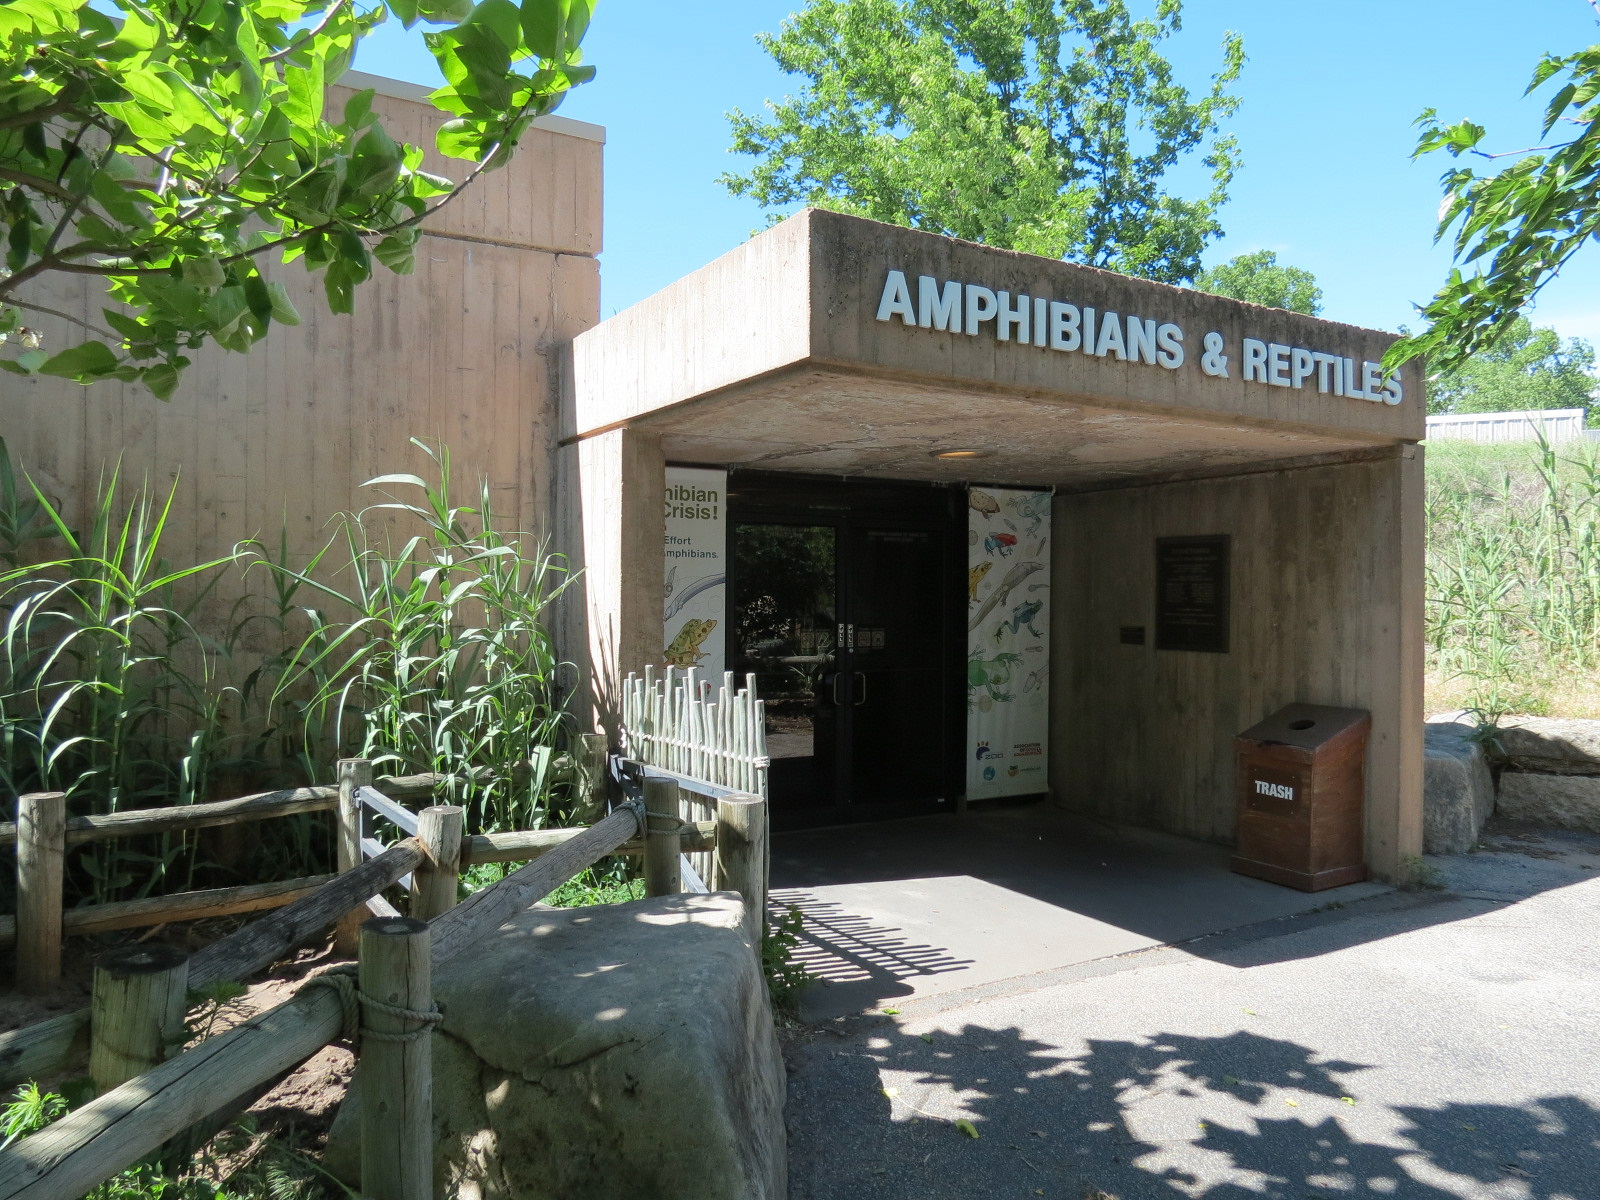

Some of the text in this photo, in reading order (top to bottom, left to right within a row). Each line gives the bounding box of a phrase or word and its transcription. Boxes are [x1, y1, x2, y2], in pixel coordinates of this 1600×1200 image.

[875, 270, 1403, 406] AMPHIBIANS & REPTILES
[664, 549, 719, 559] mphibians.
[1254, 780, 1293, 800] TRASH
